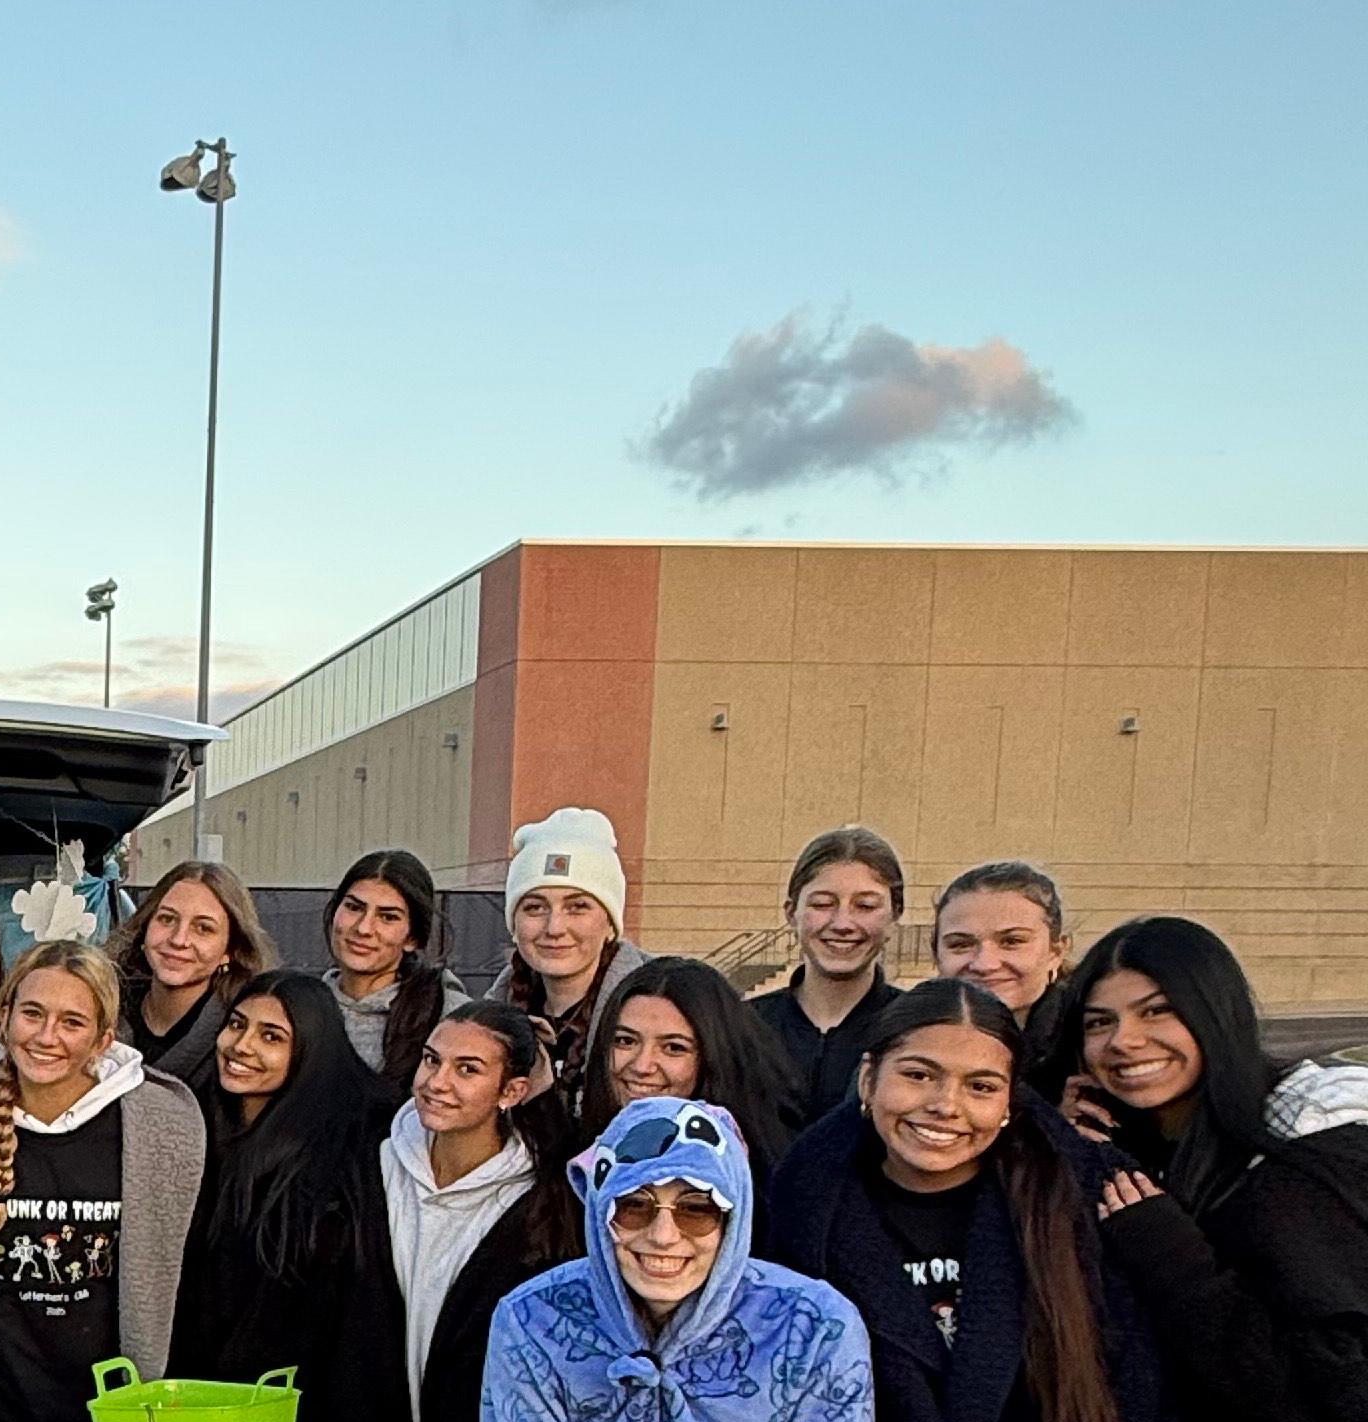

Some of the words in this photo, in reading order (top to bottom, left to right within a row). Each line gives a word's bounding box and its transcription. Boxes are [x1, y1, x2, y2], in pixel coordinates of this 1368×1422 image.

[46, 1200, 68, 1220] OR
[72, 1200, 122, 1222] TREAT
[929, 1257, 960, 1283] OR
